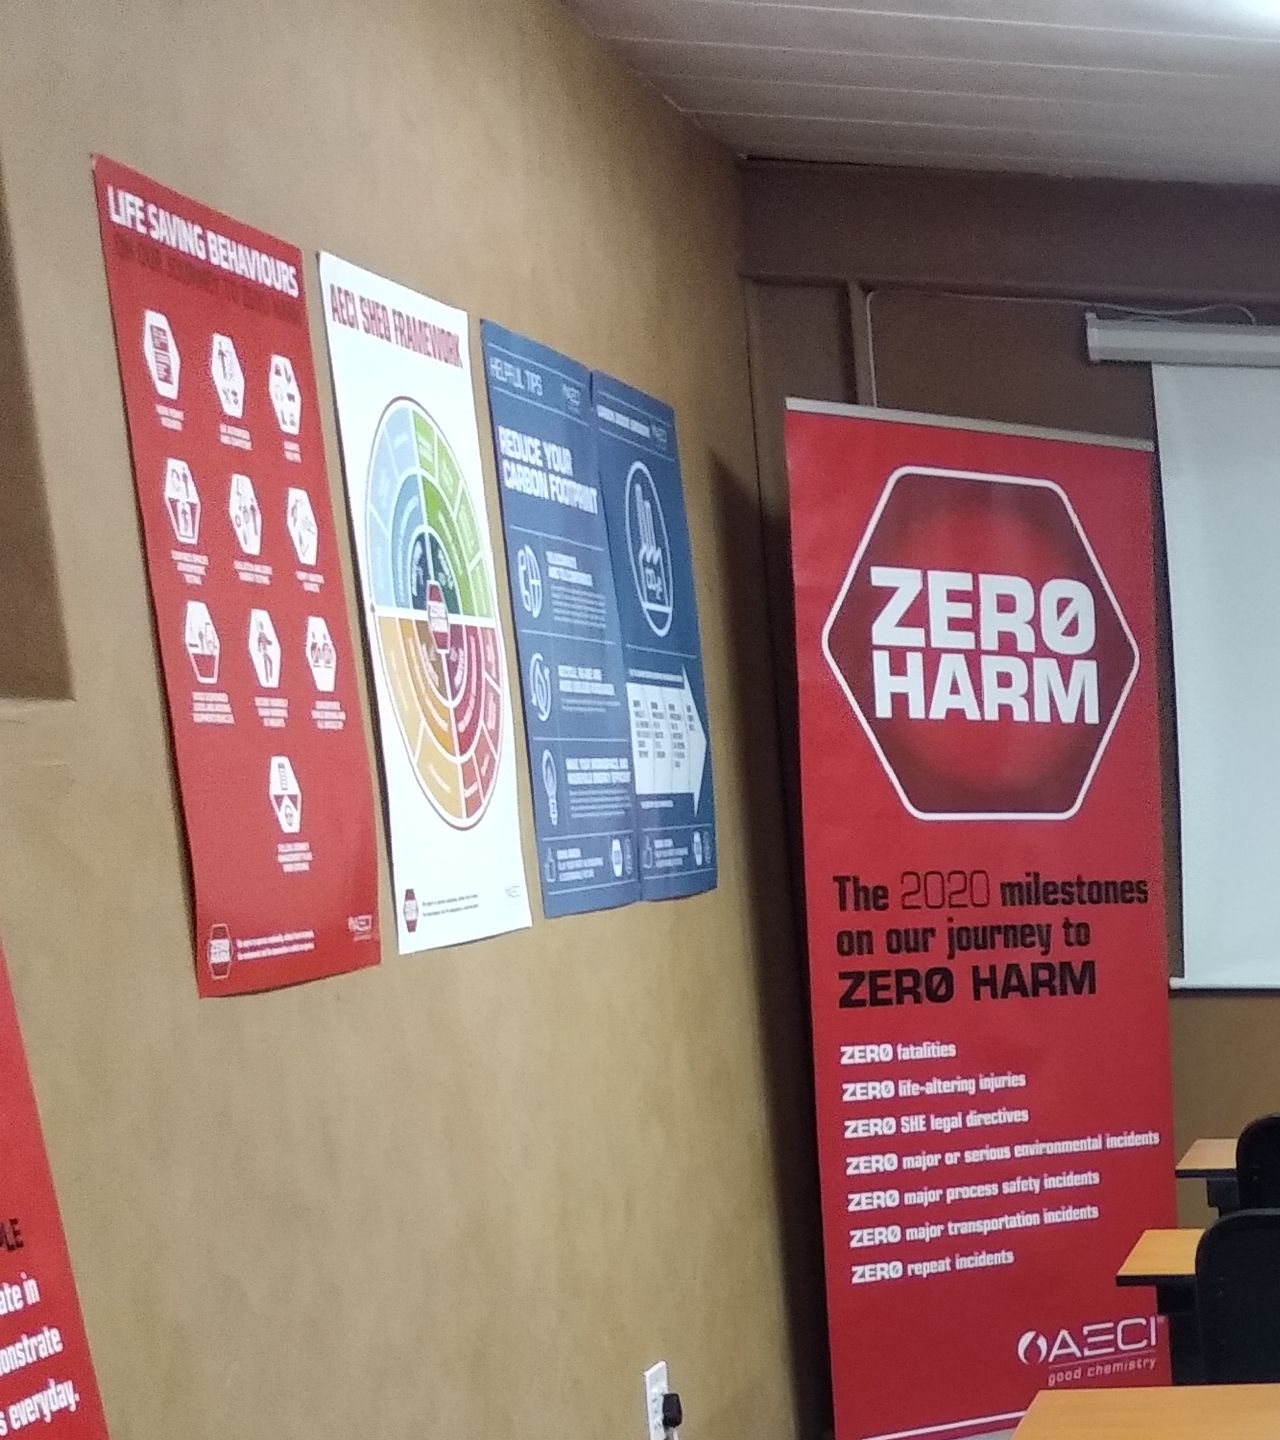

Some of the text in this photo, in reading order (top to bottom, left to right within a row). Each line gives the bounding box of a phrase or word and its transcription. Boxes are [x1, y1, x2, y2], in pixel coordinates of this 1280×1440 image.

[107, 184, 148, 235] LIFE
[147, 203, 206, 260] SAVING
[206, 229, 299, 298] BEHAVIOURS
[330, 283, 359, 330] AECI
[391, 308, 463, 369] FRAMEWORK
[524, 370, 544, 396] TIPS
[498, 425, 574, 477] REDUCE YOUR
[501, 459, 598, 514] CARBON FOOTPRINT
[872, 650, 1100, 724] HARM
[833, 870, 1149, 911] The 2020 milestones
[836, 917, 1090, 960] on our journey to
[972, 960, 1097, 1001] HARM
[897, 1040, 956, 1060] fatalities
[898, 1075, 976, 1097] life-altering
[978, 1071, 1026, 1093] injuries
[901, 1114, 926, 1133] SHE
[930, 1112, 962, 1133] legal
[966, 1106, 1029, 1127] directives
[902, 1150, 941, 1172] major
[944, 1151, 961, 1165] or
[964, 1144, 1011, 1163] serious
[1014, 1133, 1102, 1158] environmental
[1106, 1130, 1159, 1149] incidents
[904, 1186, 943, 1207] major
[946, 1182, 998, 1204] process
[1002, 1176, 1040, 1194] safety
[1044, 1170, 1099, 1189] incidents
[905, 1222, 944, 1243] major
[947, 1211, 1040, 1236] transportation
[1043, 1205, 1099, 1223] incidents
[907, 1257, 951, 1278] repeat
[955, 1250, 1014, 1270] incidents
[20, 1271, 40, 1305] in
[0, 1326, 63, 1376] onstrate
[1048, 1357, 1157, 1387] good chemistry
[9, 1378, 80, 1424] everyday.
